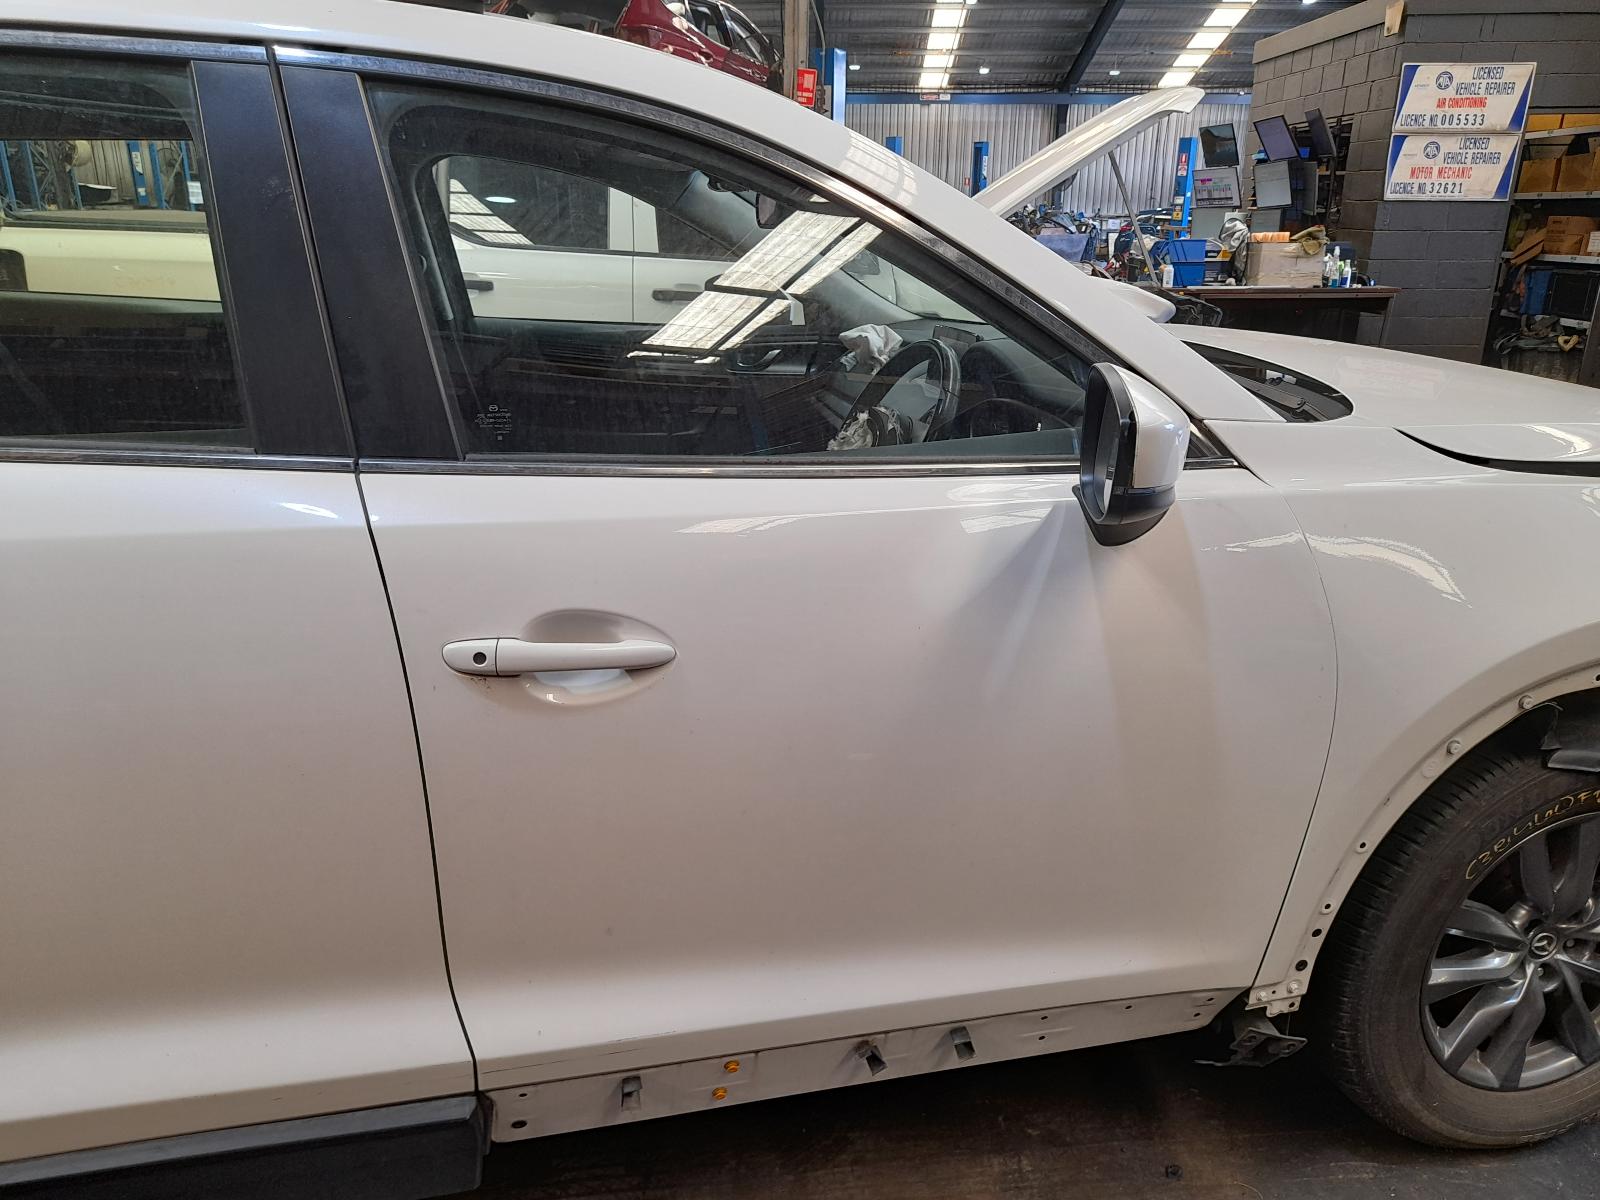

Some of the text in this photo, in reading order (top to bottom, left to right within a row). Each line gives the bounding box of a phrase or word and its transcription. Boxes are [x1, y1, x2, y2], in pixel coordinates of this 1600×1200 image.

[1472, 66, 1504, 80] LICENSED
[1455, 82, 1516, 95] VEHICLE REPAIRER
[1436, 97, 1487, 108] AIR CONDITIONING
[1400, 114, 1426, 127] LICENCE
[1459, 137, 1491, 150] LICENSED
[1443, 152, 1502, 165] VEHICLE REPAIRER
[1409, 166, 1473, 179] MOTOR MECHANIC
[1390, 182, 1415, 195] LICENCE
[1429, 182, 1463, 194] 32621
